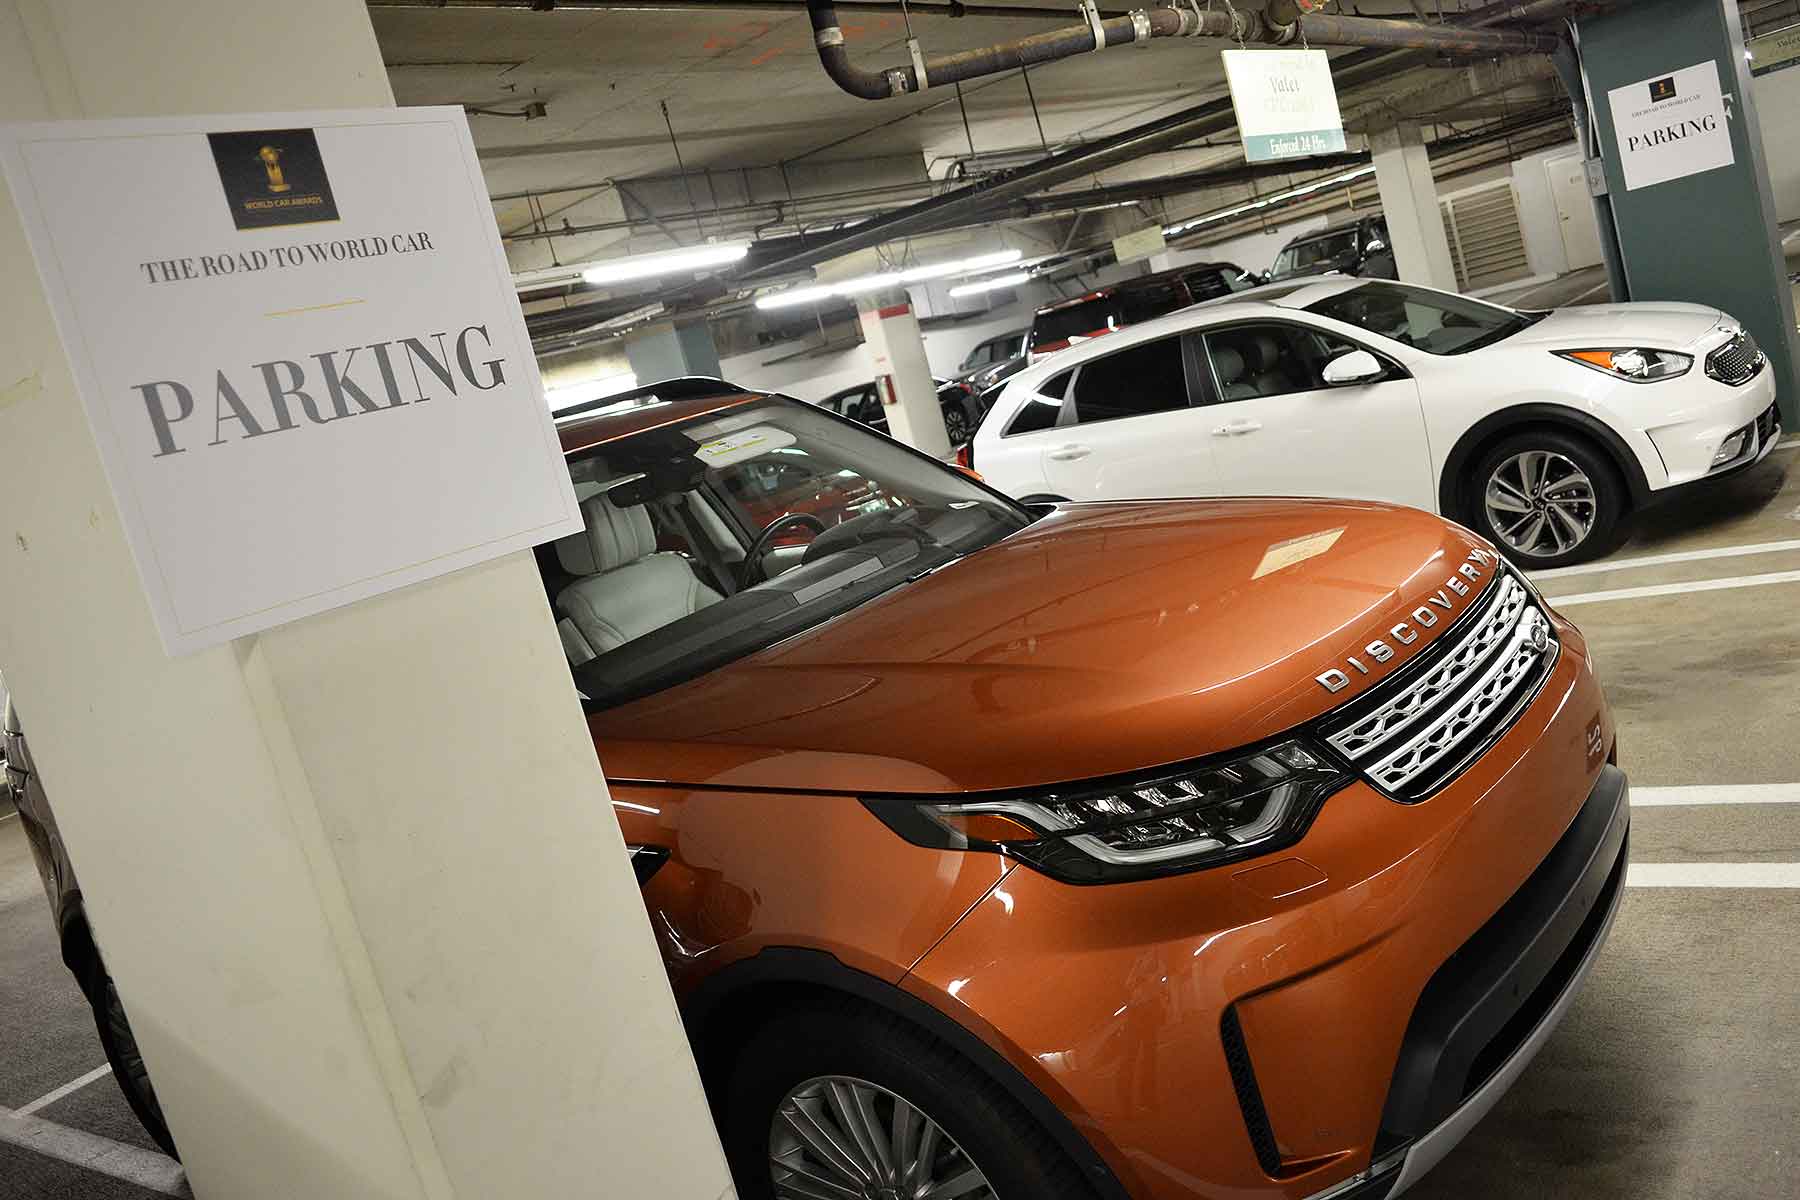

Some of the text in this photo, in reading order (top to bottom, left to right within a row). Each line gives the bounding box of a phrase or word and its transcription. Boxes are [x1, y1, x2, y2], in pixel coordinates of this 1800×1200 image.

[1300, 135, 1311, 152] 24
[1627, 114, 1716, 152] PARKING
[244, 200, 273, 210] WORLD
[274, 199, 290, 209] CAR
[139, 231, 435, 284] THE ROAD TO WORLD CAR
[130, 325, 507, 457] PARKING
[1315, 548, 1491, 693] DISCOVERY
